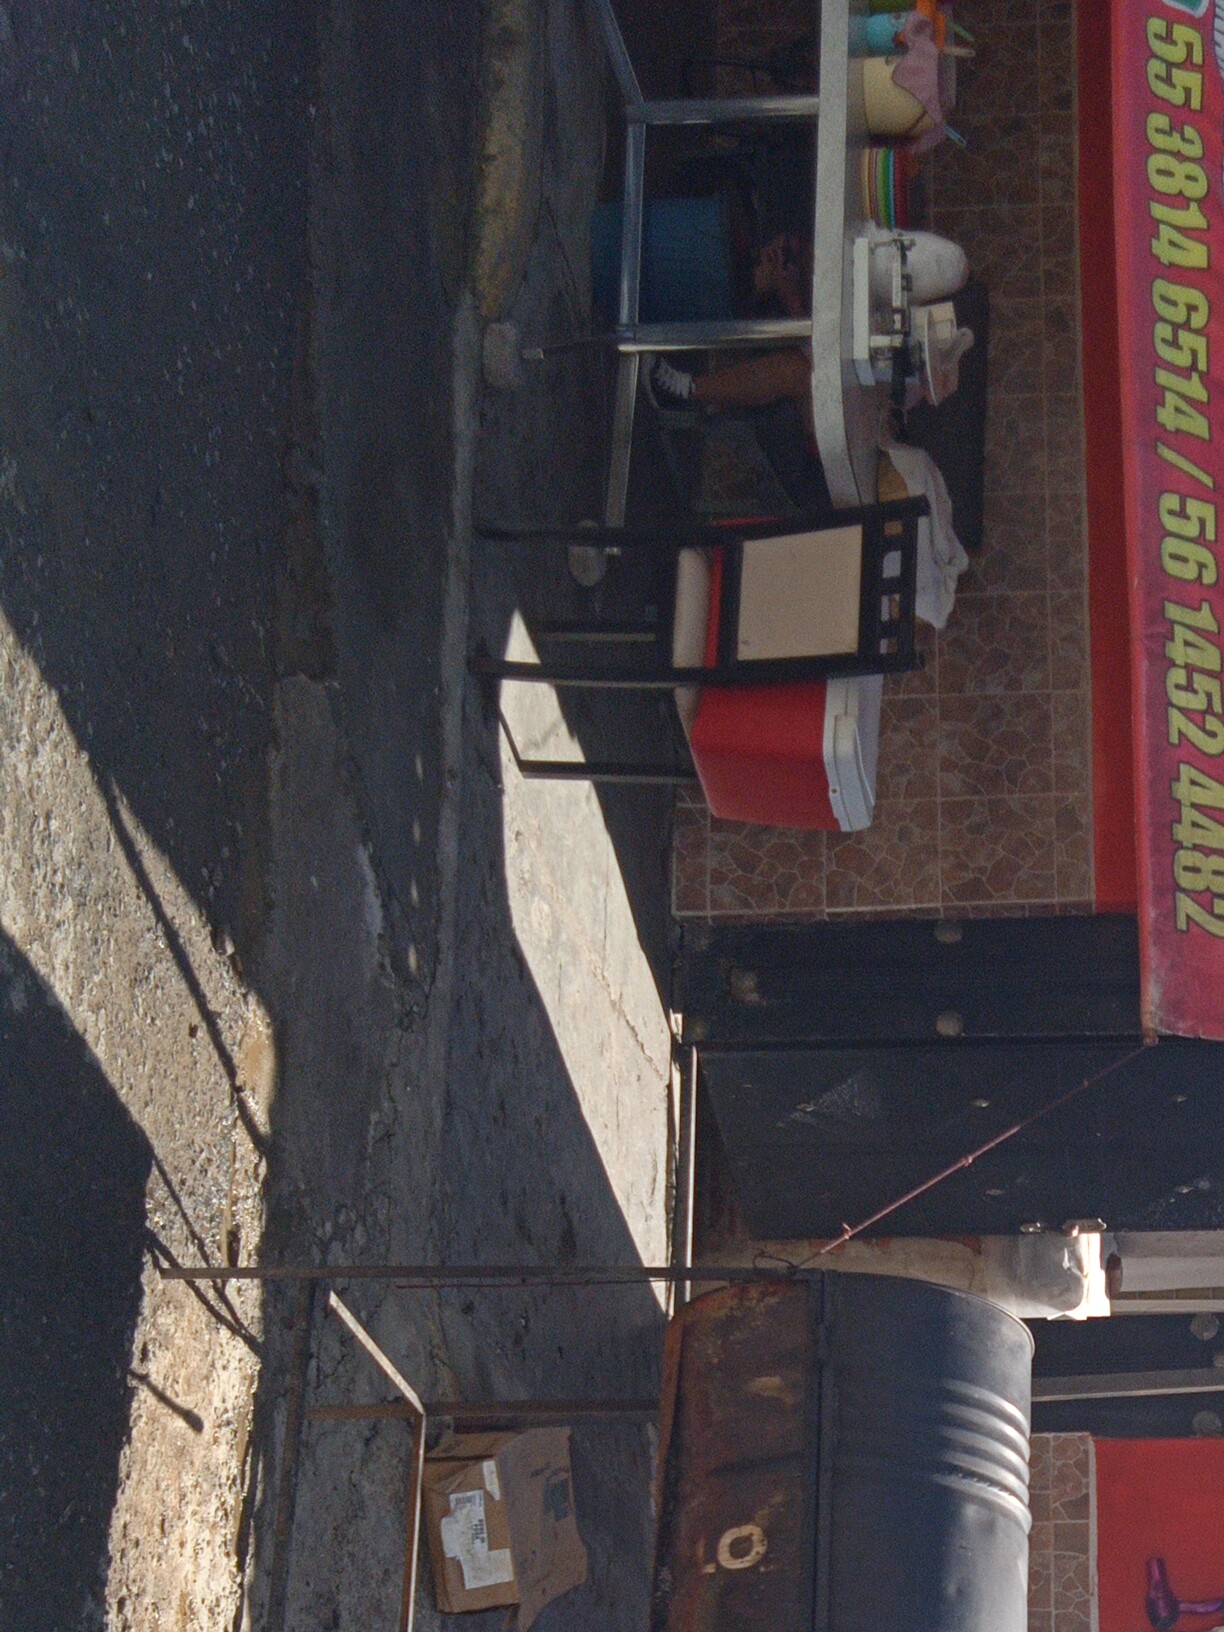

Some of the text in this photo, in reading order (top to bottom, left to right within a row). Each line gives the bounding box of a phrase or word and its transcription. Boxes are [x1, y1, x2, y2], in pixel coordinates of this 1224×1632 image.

[1146, 16, 1204, 111] 55
[1146, 112, 1209, 271] 3814
[1151, 277, 1212, 441] 6514
[1158, 492, 1218, 587] 56
